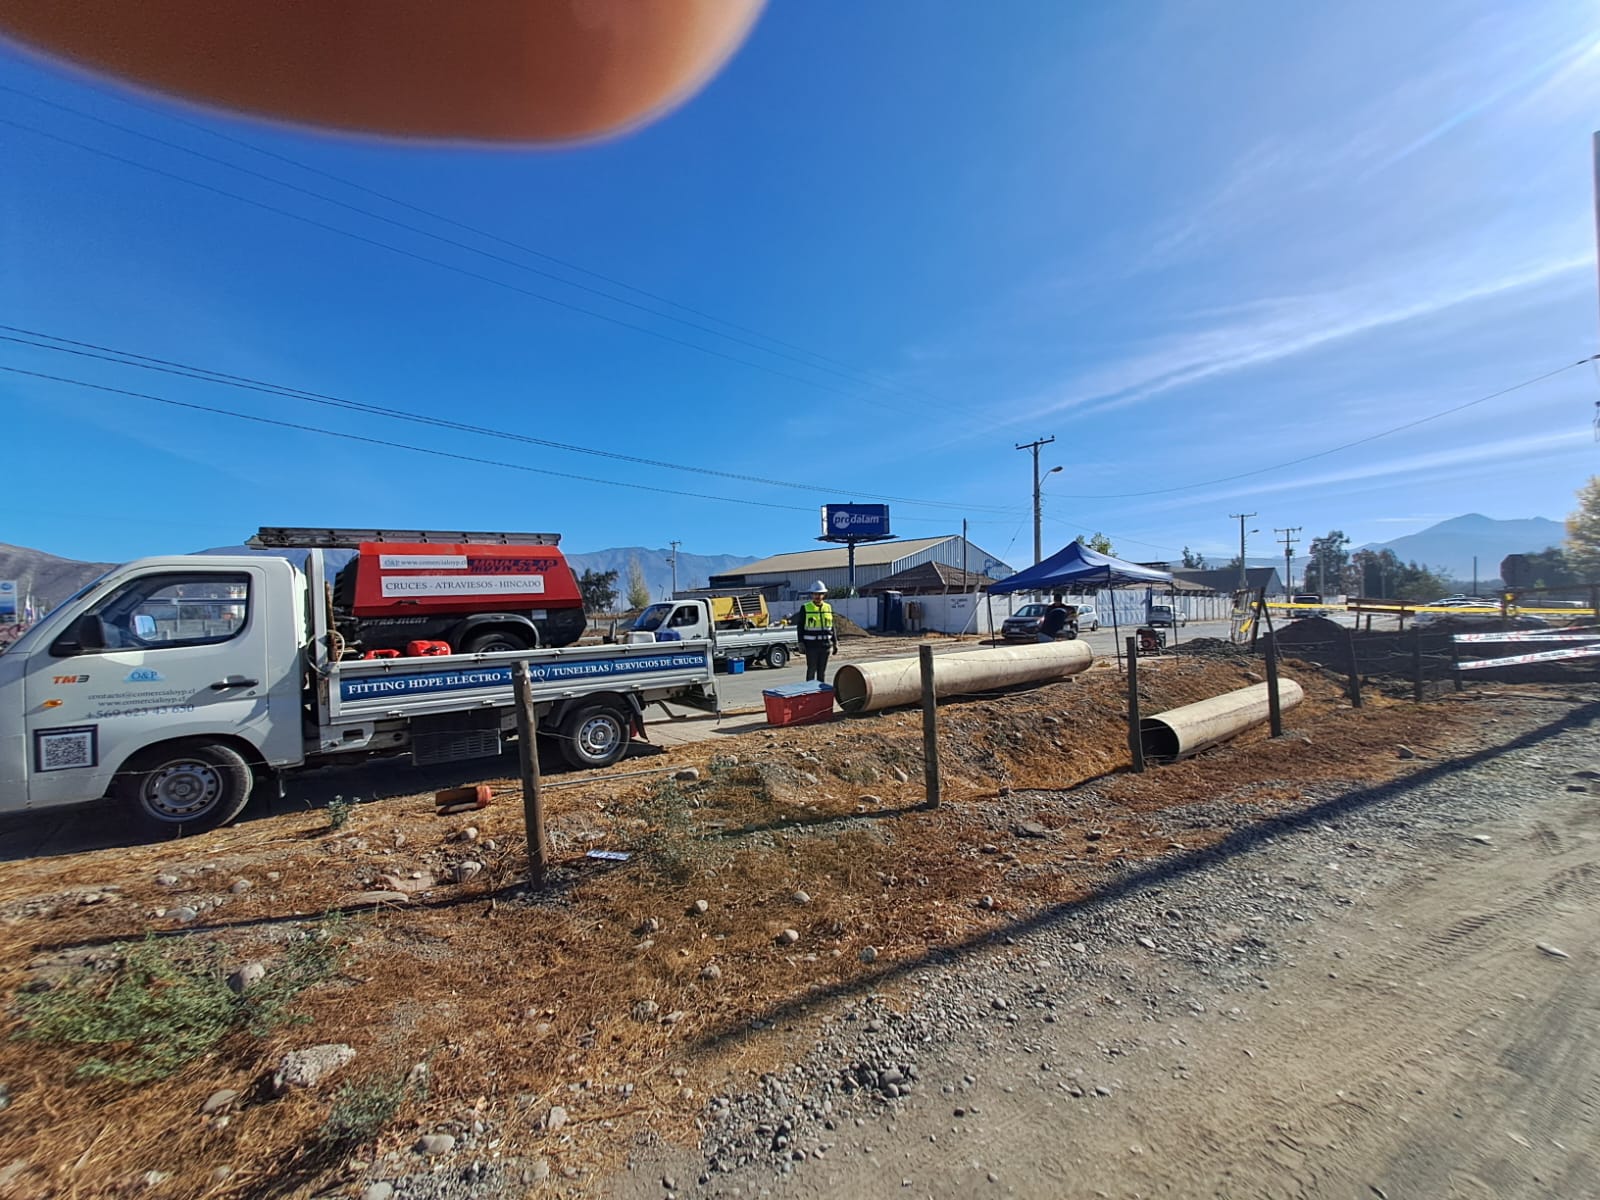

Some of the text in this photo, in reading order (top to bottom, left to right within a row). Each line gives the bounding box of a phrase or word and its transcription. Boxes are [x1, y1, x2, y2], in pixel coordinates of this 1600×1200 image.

[833, 514, 880, 525] prodalam
[385, 581, 428, 591] CRUCES
[434, 581, 493, 590] ATRAVIESOS
[499, 579, 541, 588] HINCADO
[52, 674, 90, 685] TM3
[131, 671, 158, 682] O&P
[348, 680, 405, 695] FITTING
[408, 678, 443, 689] HDPE
[446, 672, 501, 685] ELECTRO
[552, 663, 610, 677] TUNELERAS
[614, 660, 659, 672] SERVICIOS
[660, 659, 672, 668] DE
[672, 656, 703, 667] CRUCES
